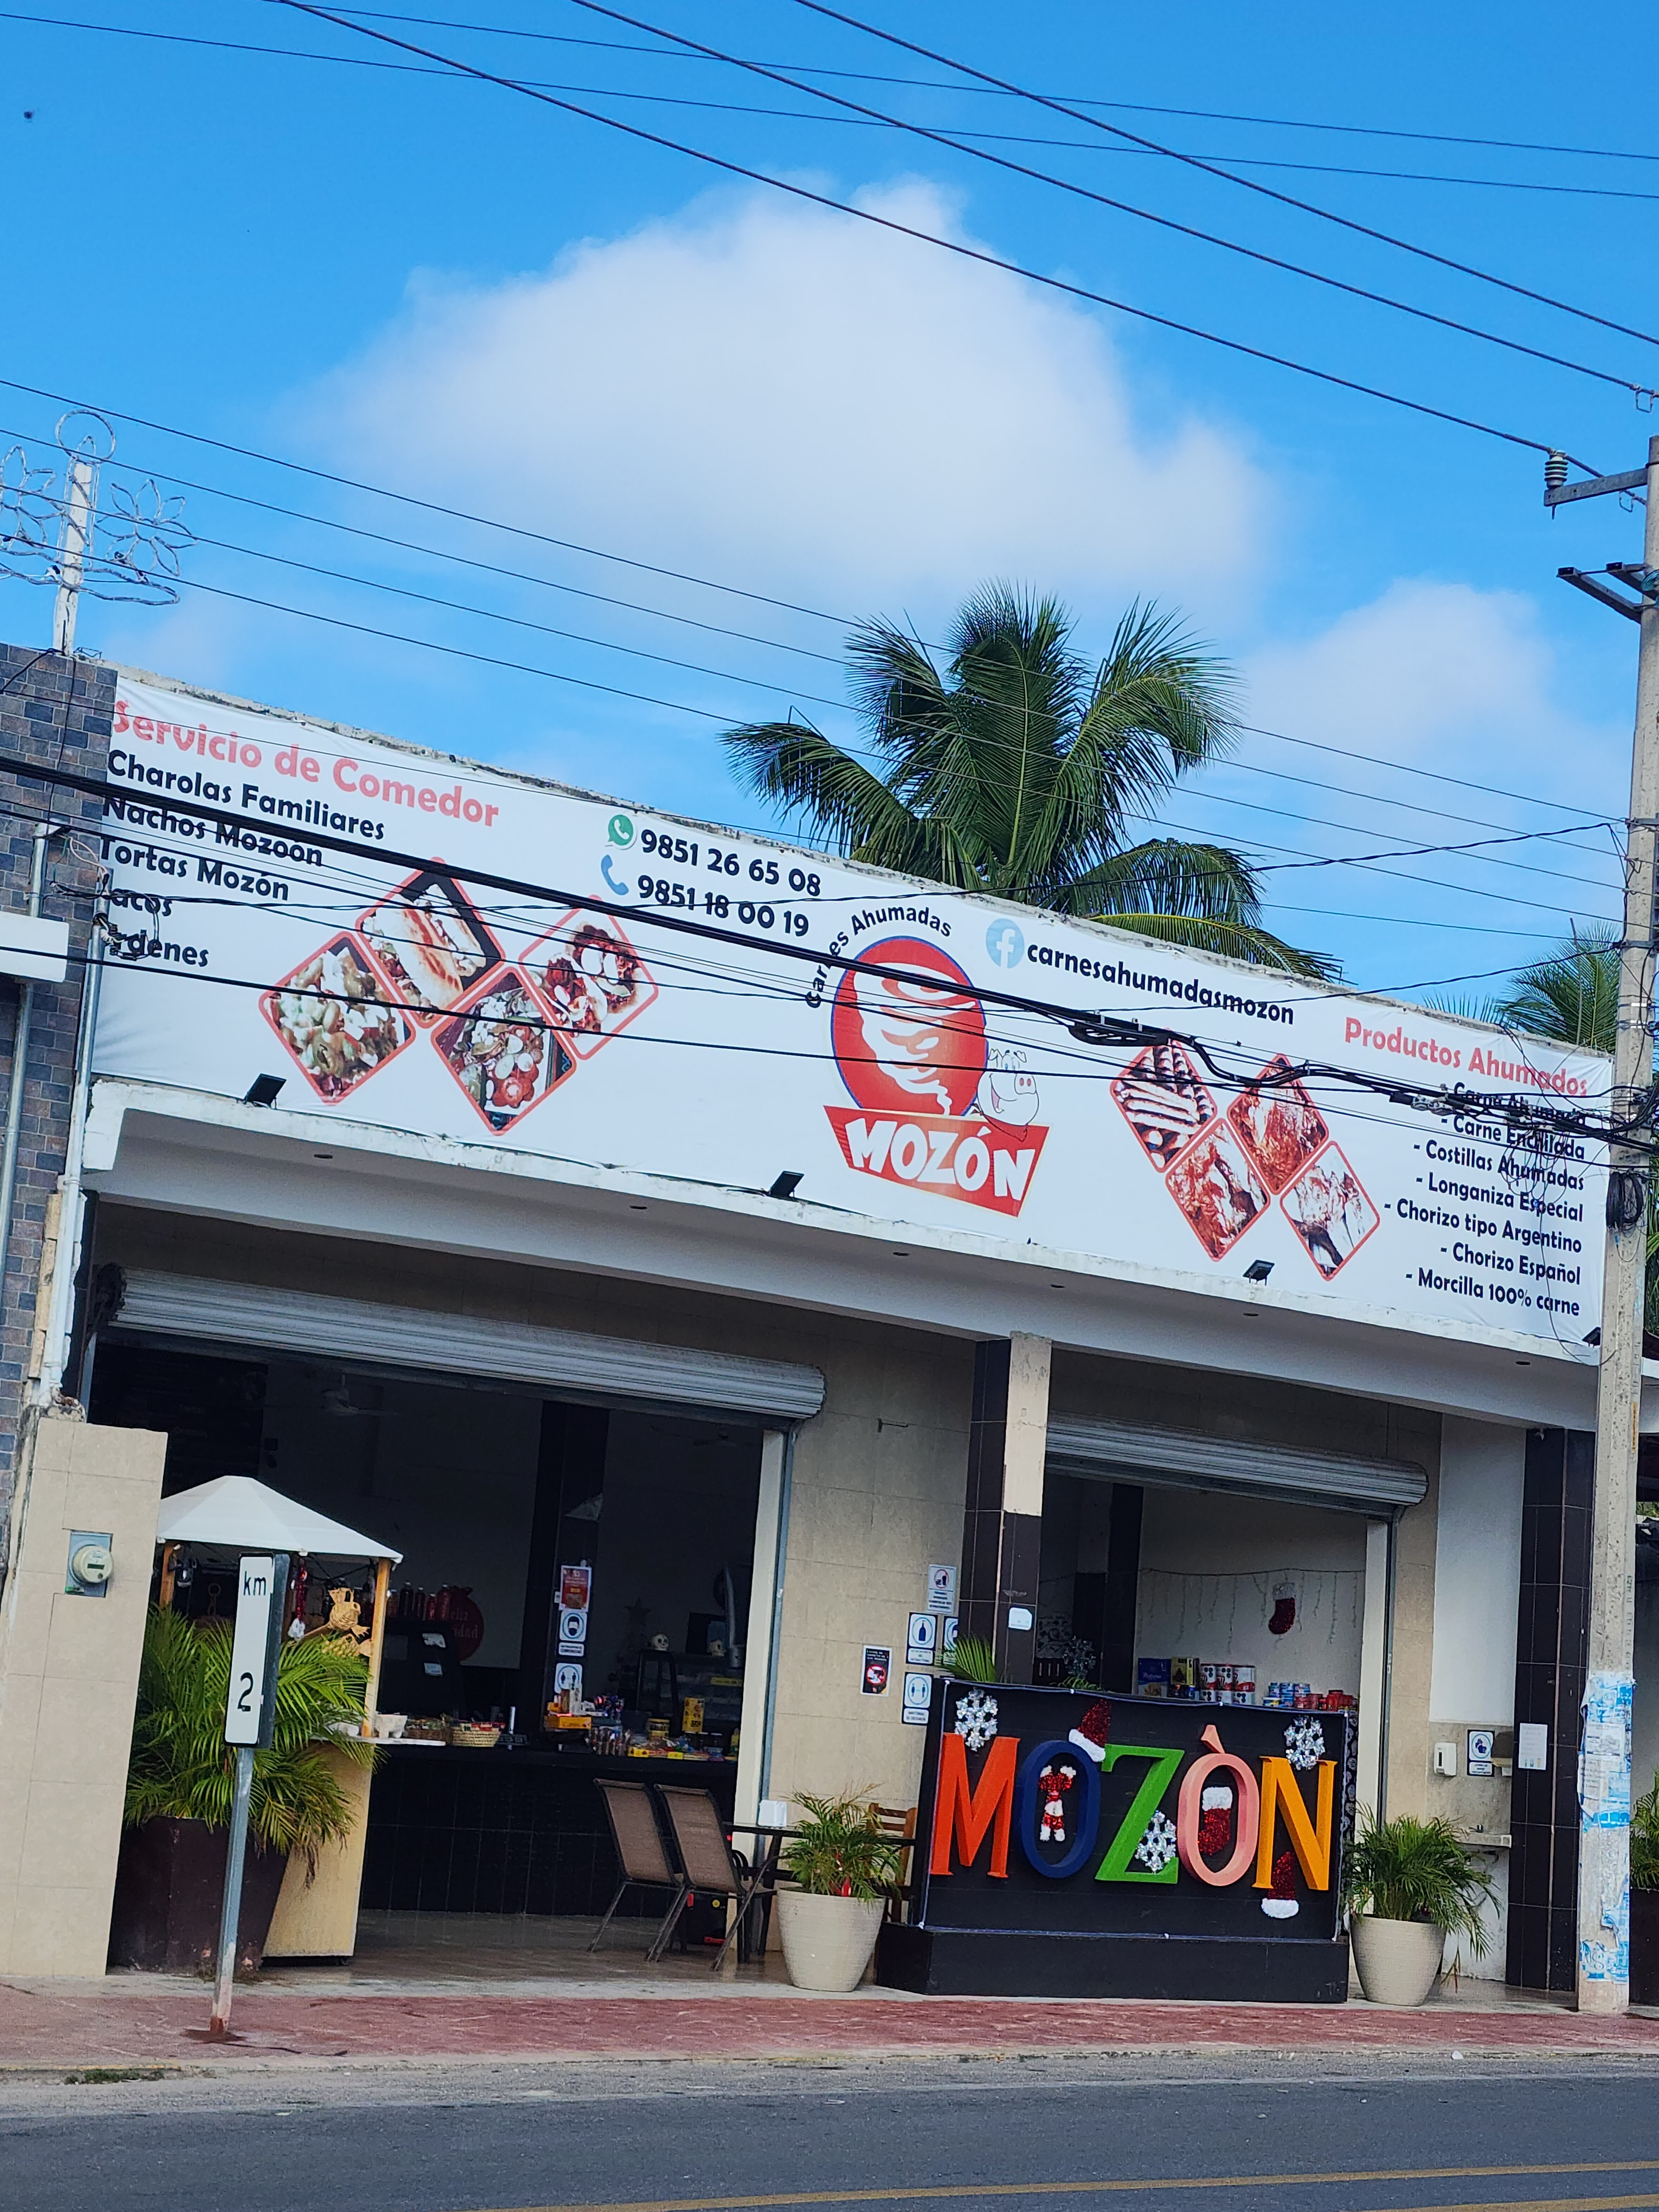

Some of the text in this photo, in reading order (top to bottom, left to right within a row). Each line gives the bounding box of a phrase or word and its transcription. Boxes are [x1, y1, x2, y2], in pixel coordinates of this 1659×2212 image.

[113, 700, 500, 827] Servicio de Comedor
[102, 796, 206, 840] Nachos
[107, 749, 385, 840] Charolas Familiares
[100, 836, 188, 878] Tortas
[641, 829, 821, 896] 9851 26 65 08
[112, 891, 173, 917] acos
[638, 875, 809, 937] 9851 18 00 19
[851, 906, 952, 937] Ahumadas
[1027, 943, 1294, 1025] carnesahumadasmozon
[1344, 1017, 1588, 1096] Productos Ahumados
[1453, 1115, 1501, 1141] Carne
[845, 1118, 1036, 1200] MOZÓN
[1425, 1140, 1493, 1173] Costillas
[1498, 1157, 1585, 1191] Ahumadas
[1428, 1171, 1515, 1209] Longaniza
[1520, 1191, 1583, 1223] Especial
[1396, 1198, 1460, 1229] Chorizo
[1465, 1215, 1497, 1239] tipo
[1502, 1219, 1582, 1253] Argentino
[1453, 1241, 1514, 1272] Chorizo
[1519, 1255, 1581, 1285] Español
[1418, 1267, 1484, 1299] Morcilla
[1488, 1283, 1531, 1308] 100%
[1536, 1294, 1580, 1317] carne
[243, 1570, 267, 1596] km
[237, 1671, 254, 1712] 2
